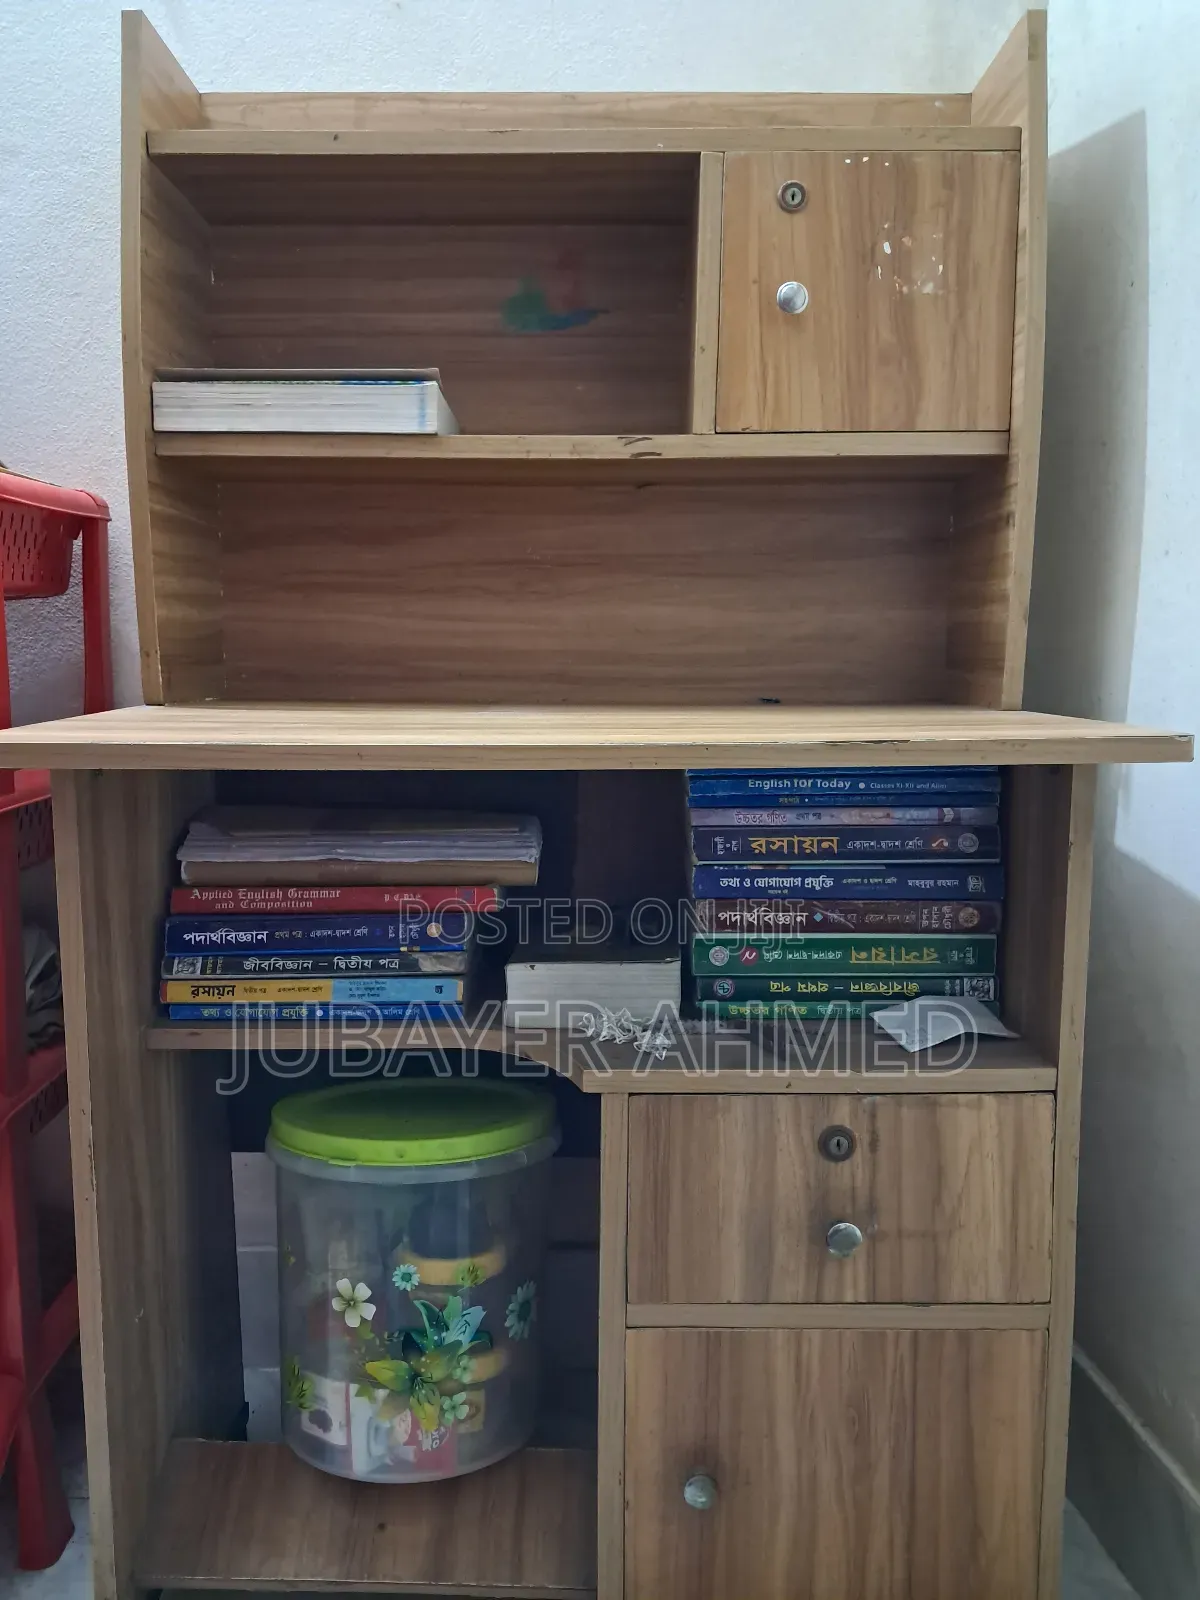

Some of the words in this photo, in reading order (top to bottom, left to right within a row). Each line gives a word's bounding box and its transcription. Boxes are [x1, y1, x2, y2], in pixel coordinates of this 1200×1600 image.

[748, 778, 791, 790] English
[816, 778, 852, 790] Today
[748, 835, 840, 855] রসায়ন
[719, 876, 740, 888] তথ্য
[743, 878, 751, 887] ও
[754, 876, 802, 888] যোগাযোগ
[804, 875, 834, 891] প্রযুক্তি
[937, 879, 960, 888] রহমান
[190, 888, 233, 901] Applied
[238, 888, 283, 901] English
[287, 887, 341, 899] Grammar
[215, 901, 234, 909] and
[240, 899, 313, 910] Composition
[717, 907, 809, 927] পদার্থবিজ্ঞান
[182, 928, 269, 945] পদার্থবিজ্ঞান
[274, 930, 290, 940] প্রথম
[849, 945, 941, 966] রসায়ন
[243, 956, 313, 972] জীববিজ্ঞান
[379, 957, 400, 970] পত্র
[191, 985, 236, 999] রসায়ন
[769, 981, 791, 993] পত্র
[796, 981, 829, 993] প্রথম
[850, 981, 920, 996] জীববিজ্ঞান
[201, 1008, 220, 1018] তথ্য
[224, 1008, 231, 1017] ও
[235, 1007, 278, 1018] যোগাযোগ
[281, 1006, 309, 1019] প্রযুক্তি
